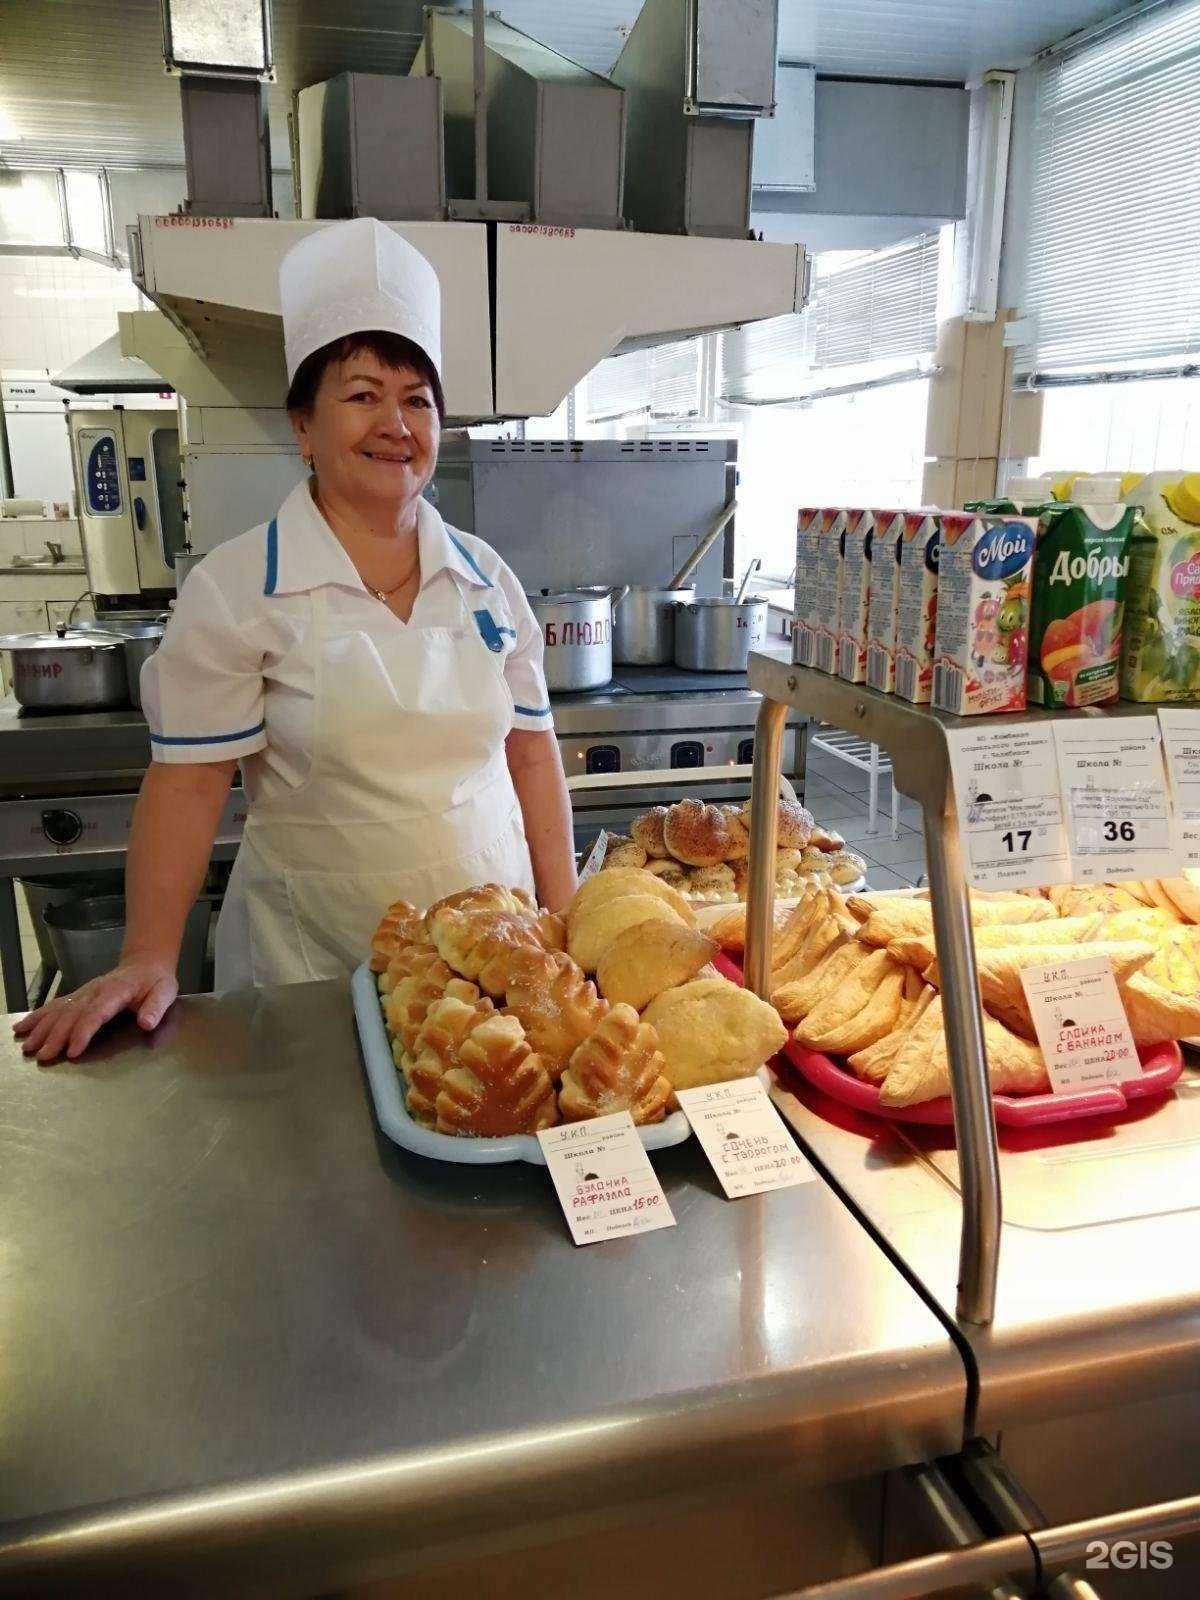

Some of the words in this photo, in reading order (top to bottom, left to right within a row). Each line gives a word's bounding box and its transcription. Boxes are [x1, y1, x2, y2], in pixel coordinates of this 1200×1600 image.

[978, 532, 1027, 568] Мой
[974, 762, 1010, 771] Школа
[1077, 760, 1109, 768] Школа
[1104, 821, 1135, 841] 36
[1002, 830, 1032, 852] 17
[1066, 1032, 1123, 1052] БАНАНОМ
[564, 1148, 595, 1159] Школа
[723, 1136, 769, 1152] СОЧЕНЬ
[732, 1143, 789, 1161] ТВОРОГОМ
[576, 1176, 629, 1195] БУЛОЧКА
[572, 1187, 631, 1208] РАФАЭЛЛО
